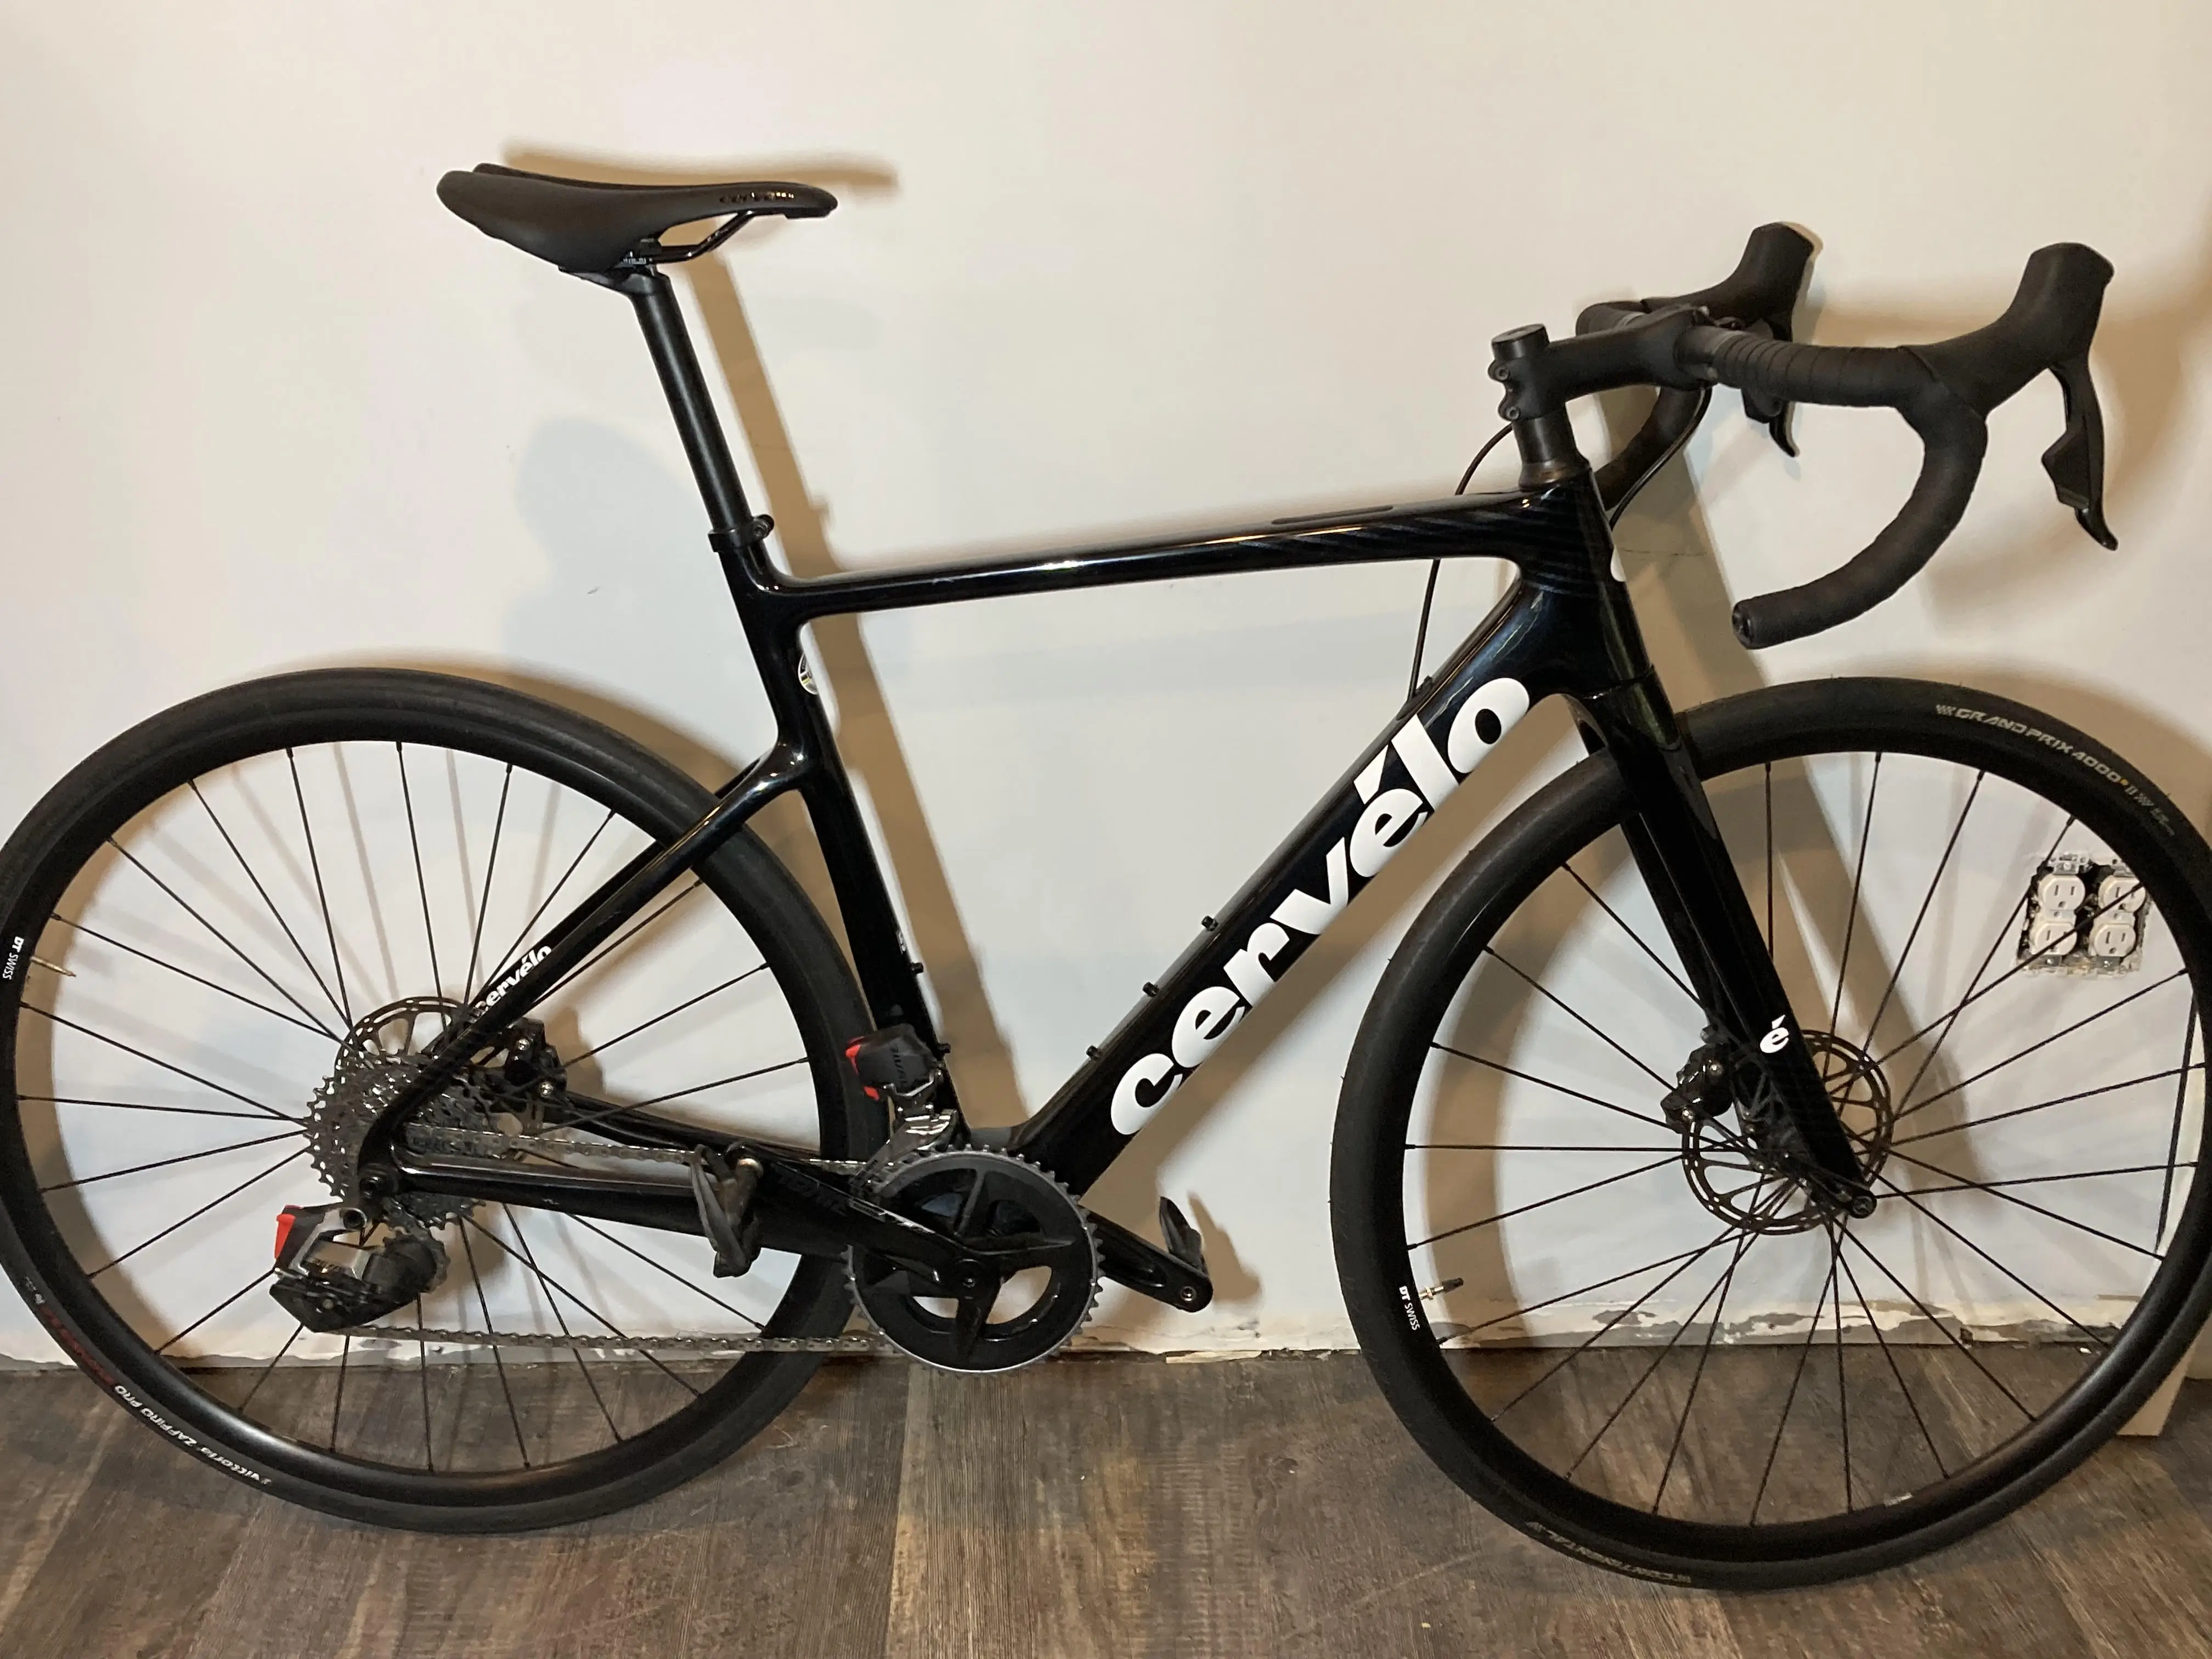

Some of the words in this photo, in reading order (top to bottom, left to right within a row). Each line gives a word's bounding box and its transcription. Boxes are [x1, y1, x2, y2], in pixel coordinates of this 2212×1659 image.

[1955, 708, 2028, 734] GRAND
[2025, 728, 2074, 754] PRIX
[2072, 752, 2121, 783] 4000
[1110, 677, 1530, 1136] cervélo
[12, 936, 24, 953] DT
[2, 952, 19, 980] SWISS
[1399, 1285, 1411, 1301] DT
[1404, 1302, 1420, 1330] SWISS
[114, 1385, 143, 1408] PRO
[140, 1408, 198, 1447] ZAFFIRO
